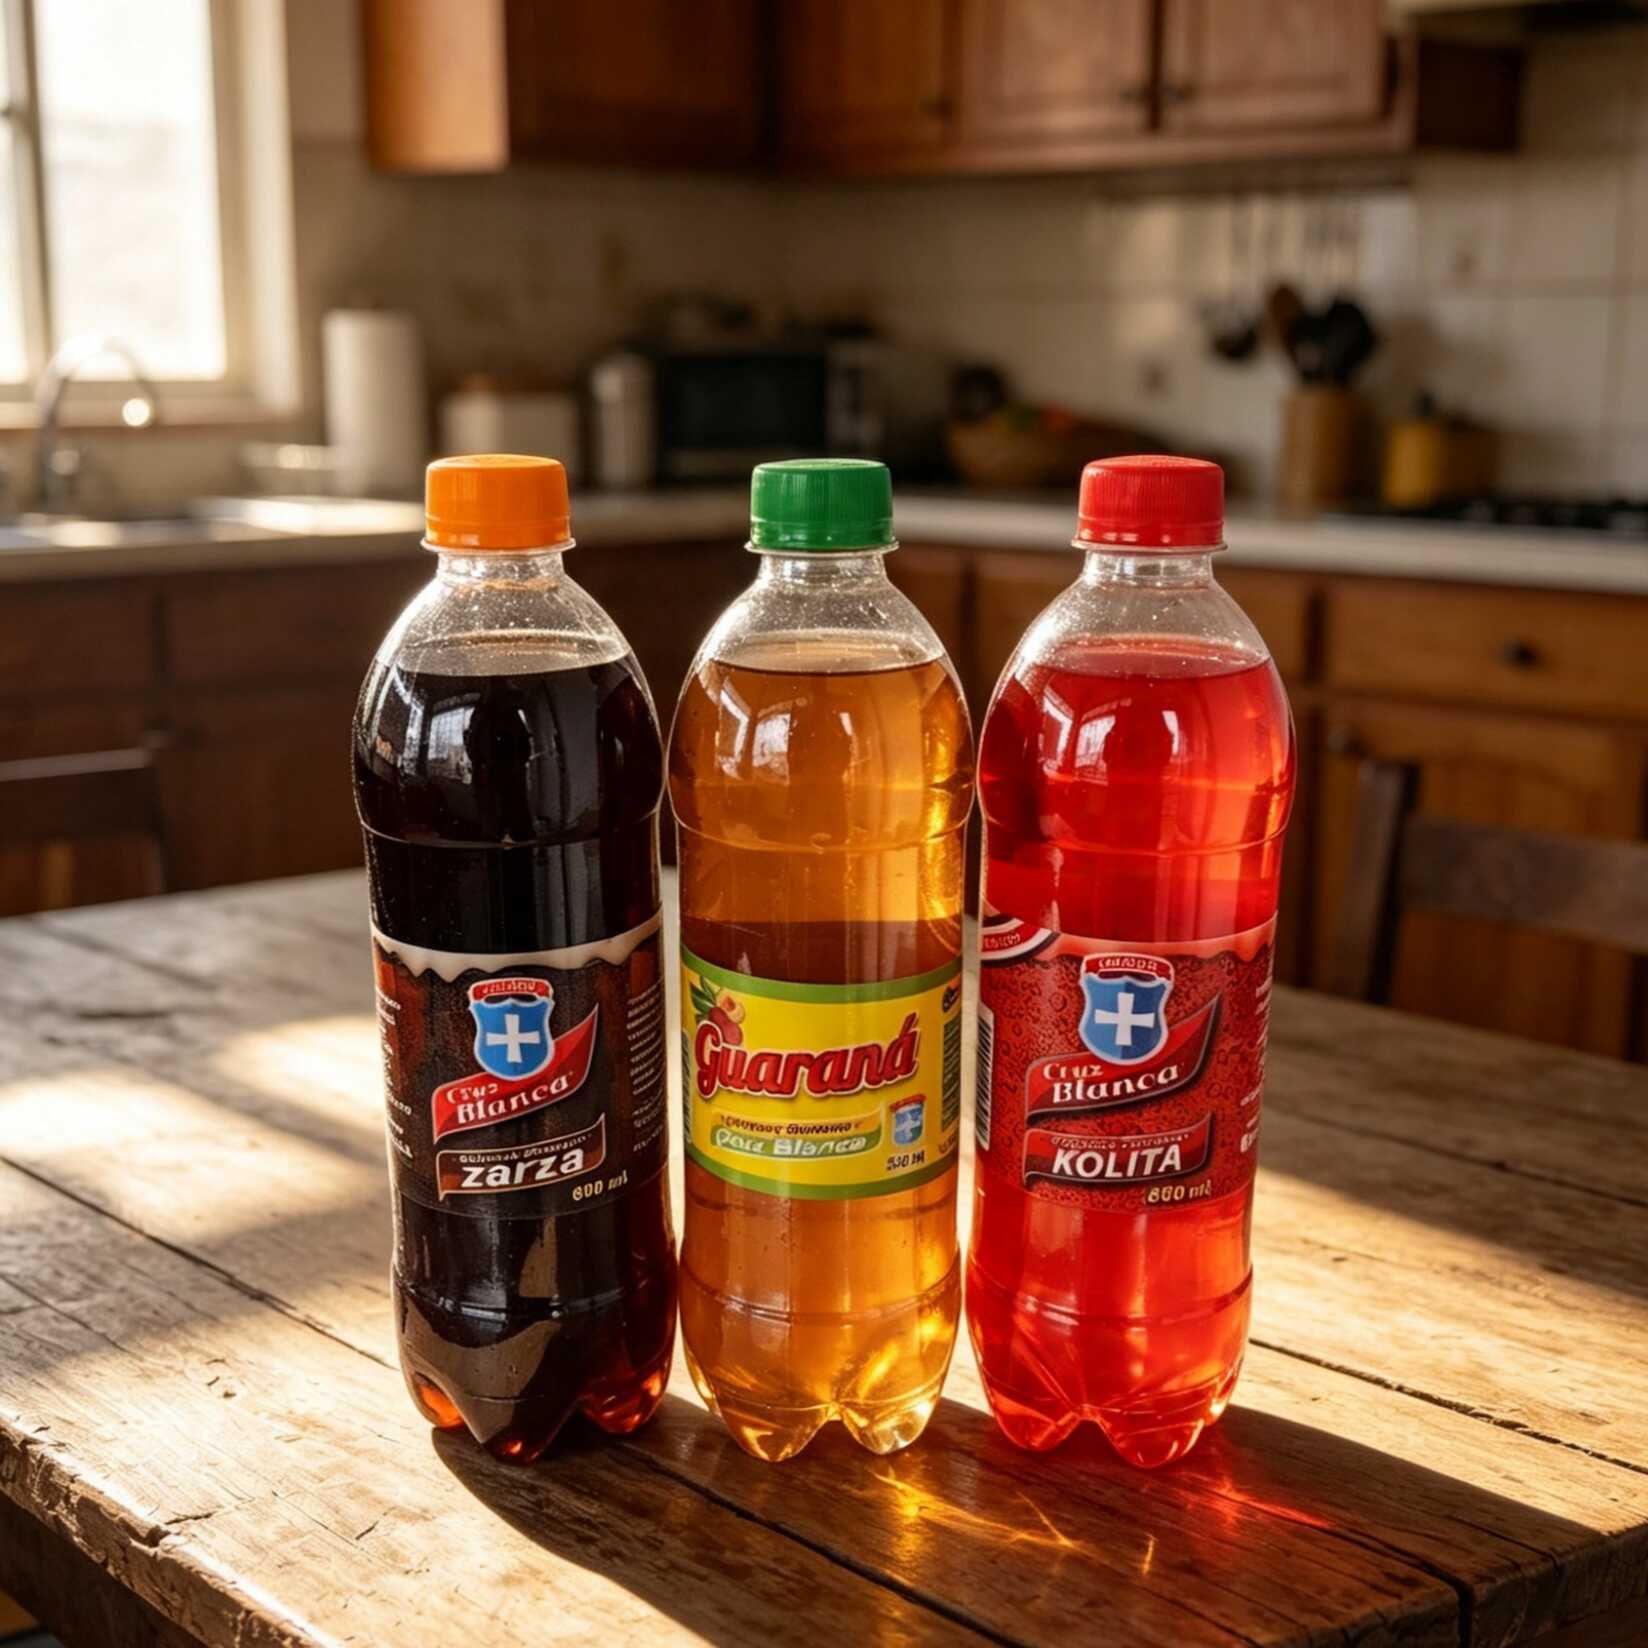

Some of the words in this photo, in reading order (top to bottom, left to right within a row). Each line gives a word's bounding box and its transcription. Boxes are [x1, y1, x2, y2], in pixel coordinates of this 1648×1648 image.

[694, 1012, 919, 1098] Guaraná
[1043, 1062, 1104, 1080] Cruz
[1051, 1143, 1182, 1179] KOLITA
